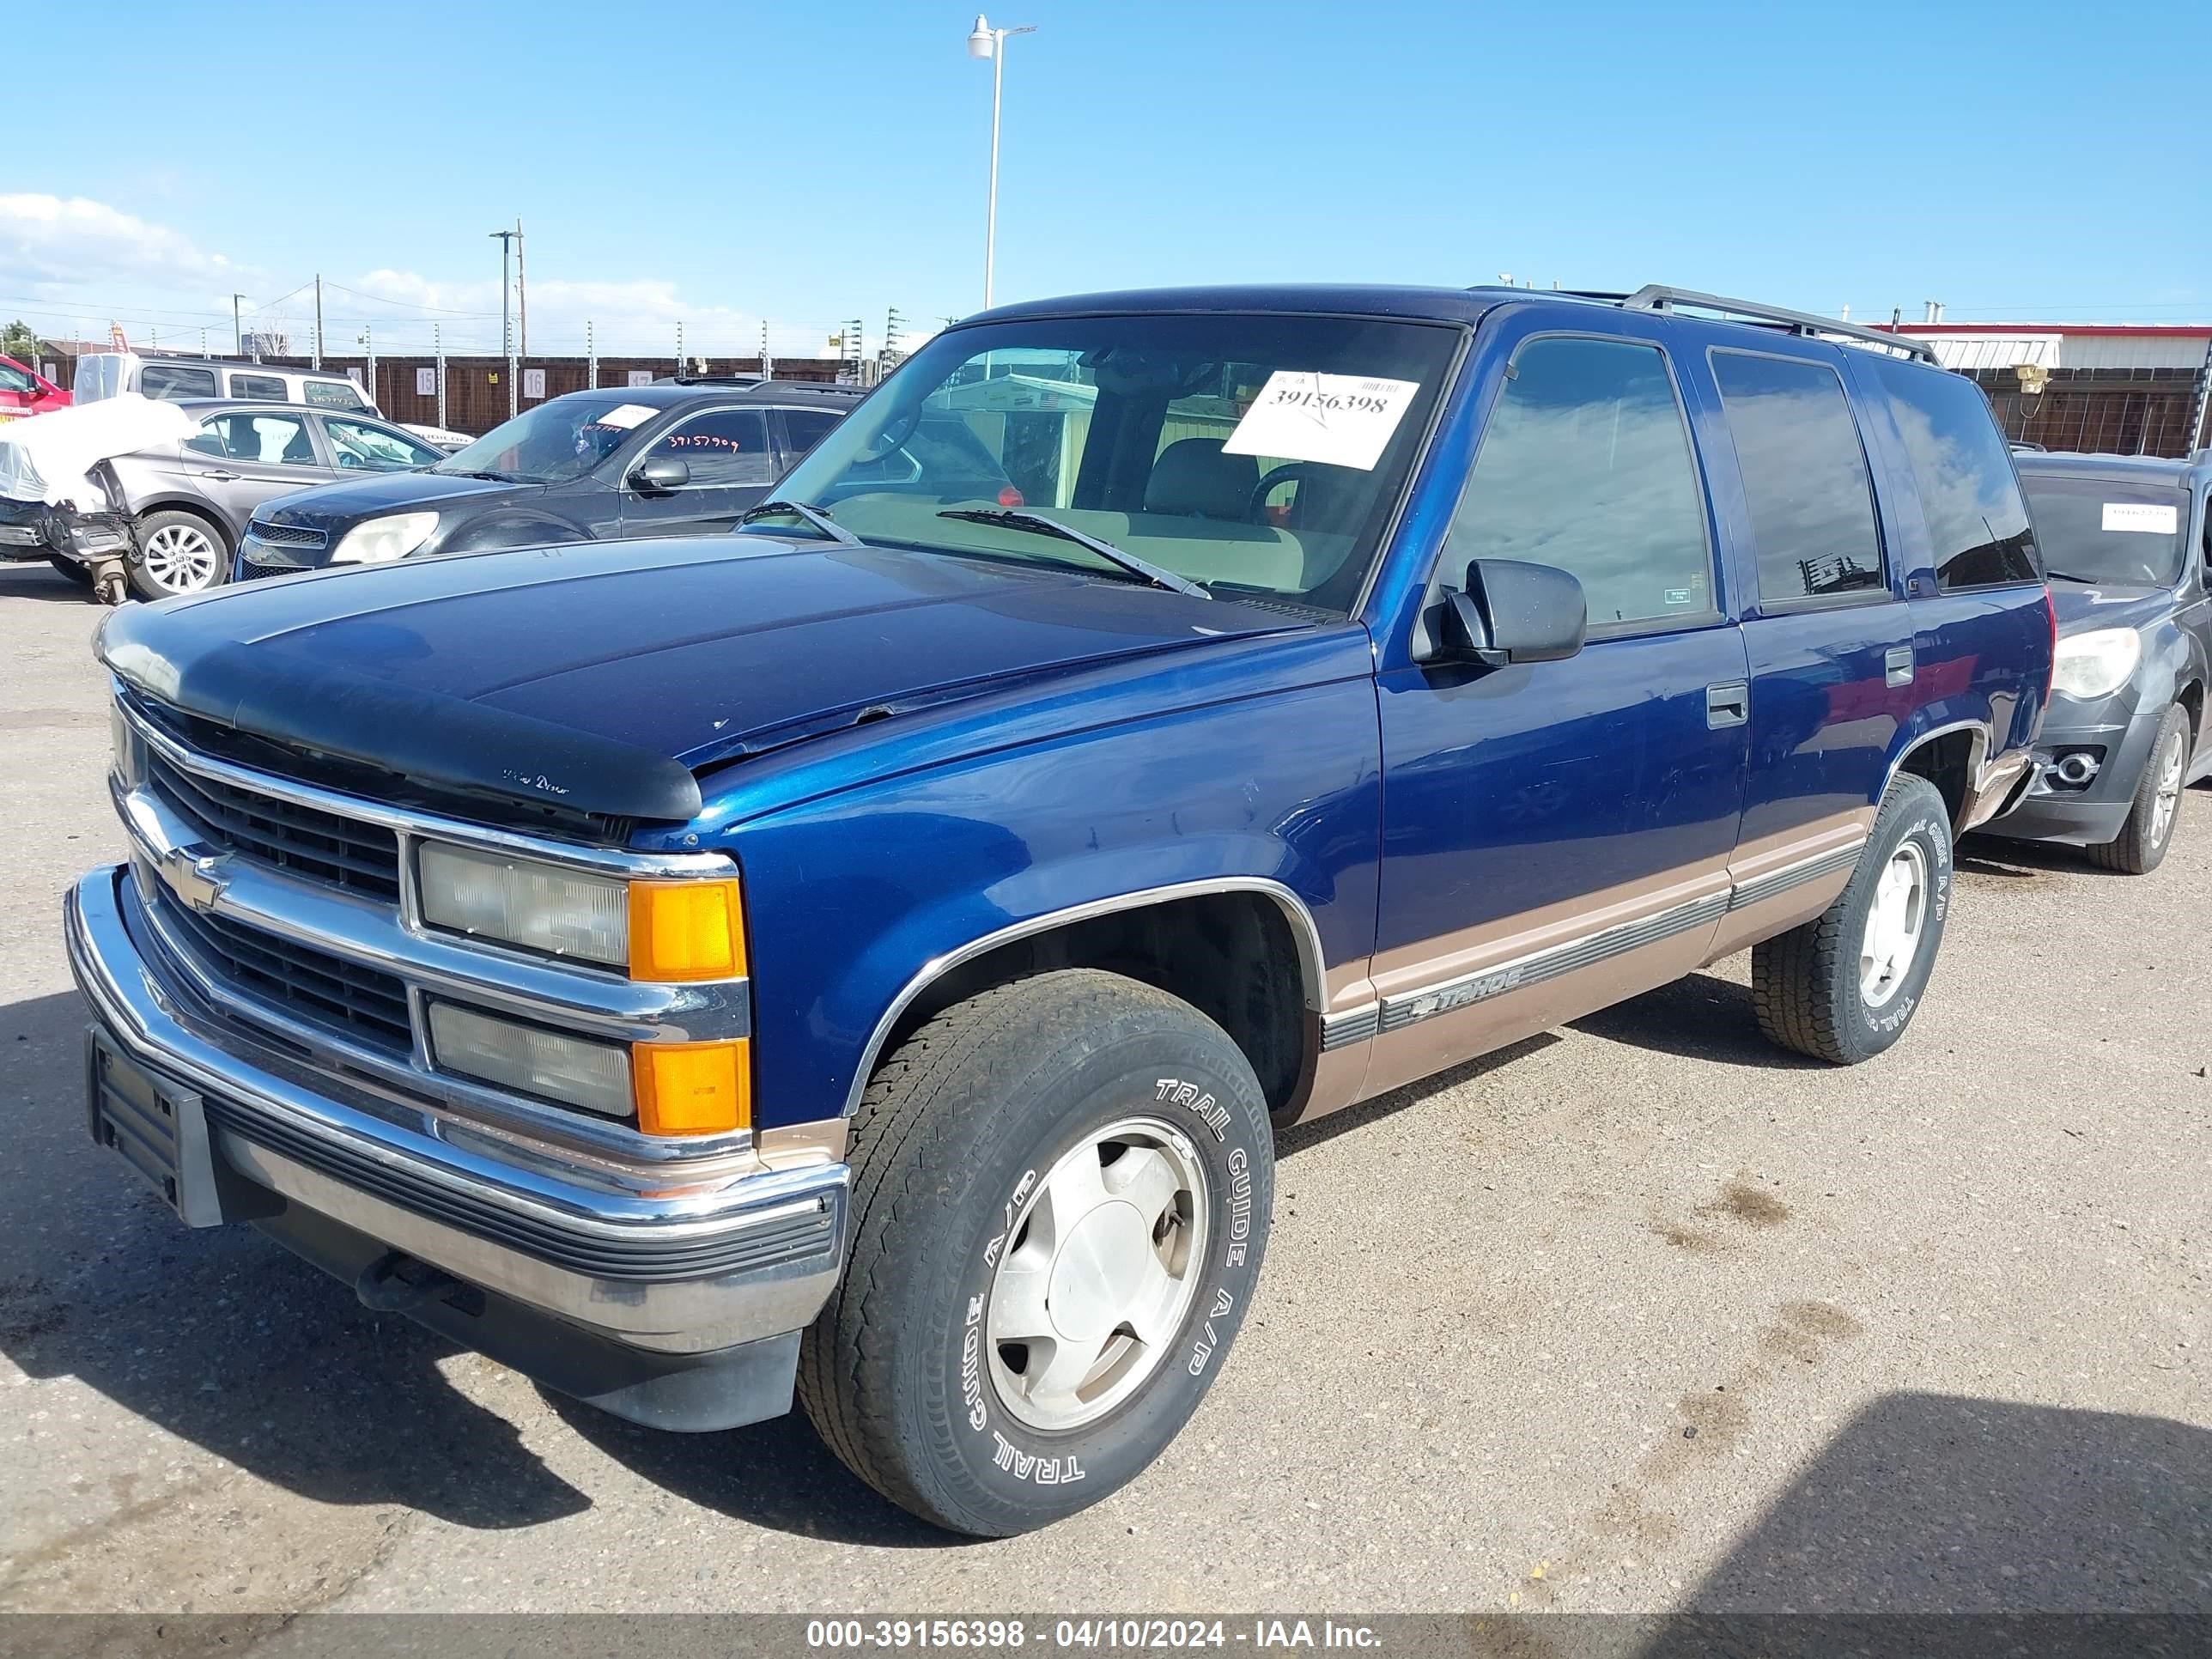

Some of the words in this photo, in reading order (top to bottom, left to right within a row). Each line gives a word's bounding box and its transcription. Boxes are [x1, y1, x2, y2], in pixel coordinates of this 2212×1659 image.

[420, 372, 433, 390] 15
[528, 374, 542, 393] 16
[1269, 390, 1388, 413] 39156398
[419, 434, 468, 442] UBICON
[668, 436, 739, 453] 39157909
[1928, 823, 1948, 868] GUIDE
[1936, 876, 1948, 921] A/P
[1440, 967, 1525, 1009] TAHOE
[1881, 996, 1914, 1031] TRAIL
[1155, 1079, 1231, 1142] TRAIL
[983, 1170, 1036, 1268] A/P
[1225, 1148, 1251, 1267] GUIDE
[1188, 1288, 1233, 1376] A/P
[962, 1292, 987, 1431] GUIDE
[992, 1430, 1085, 1485] TRAIL
